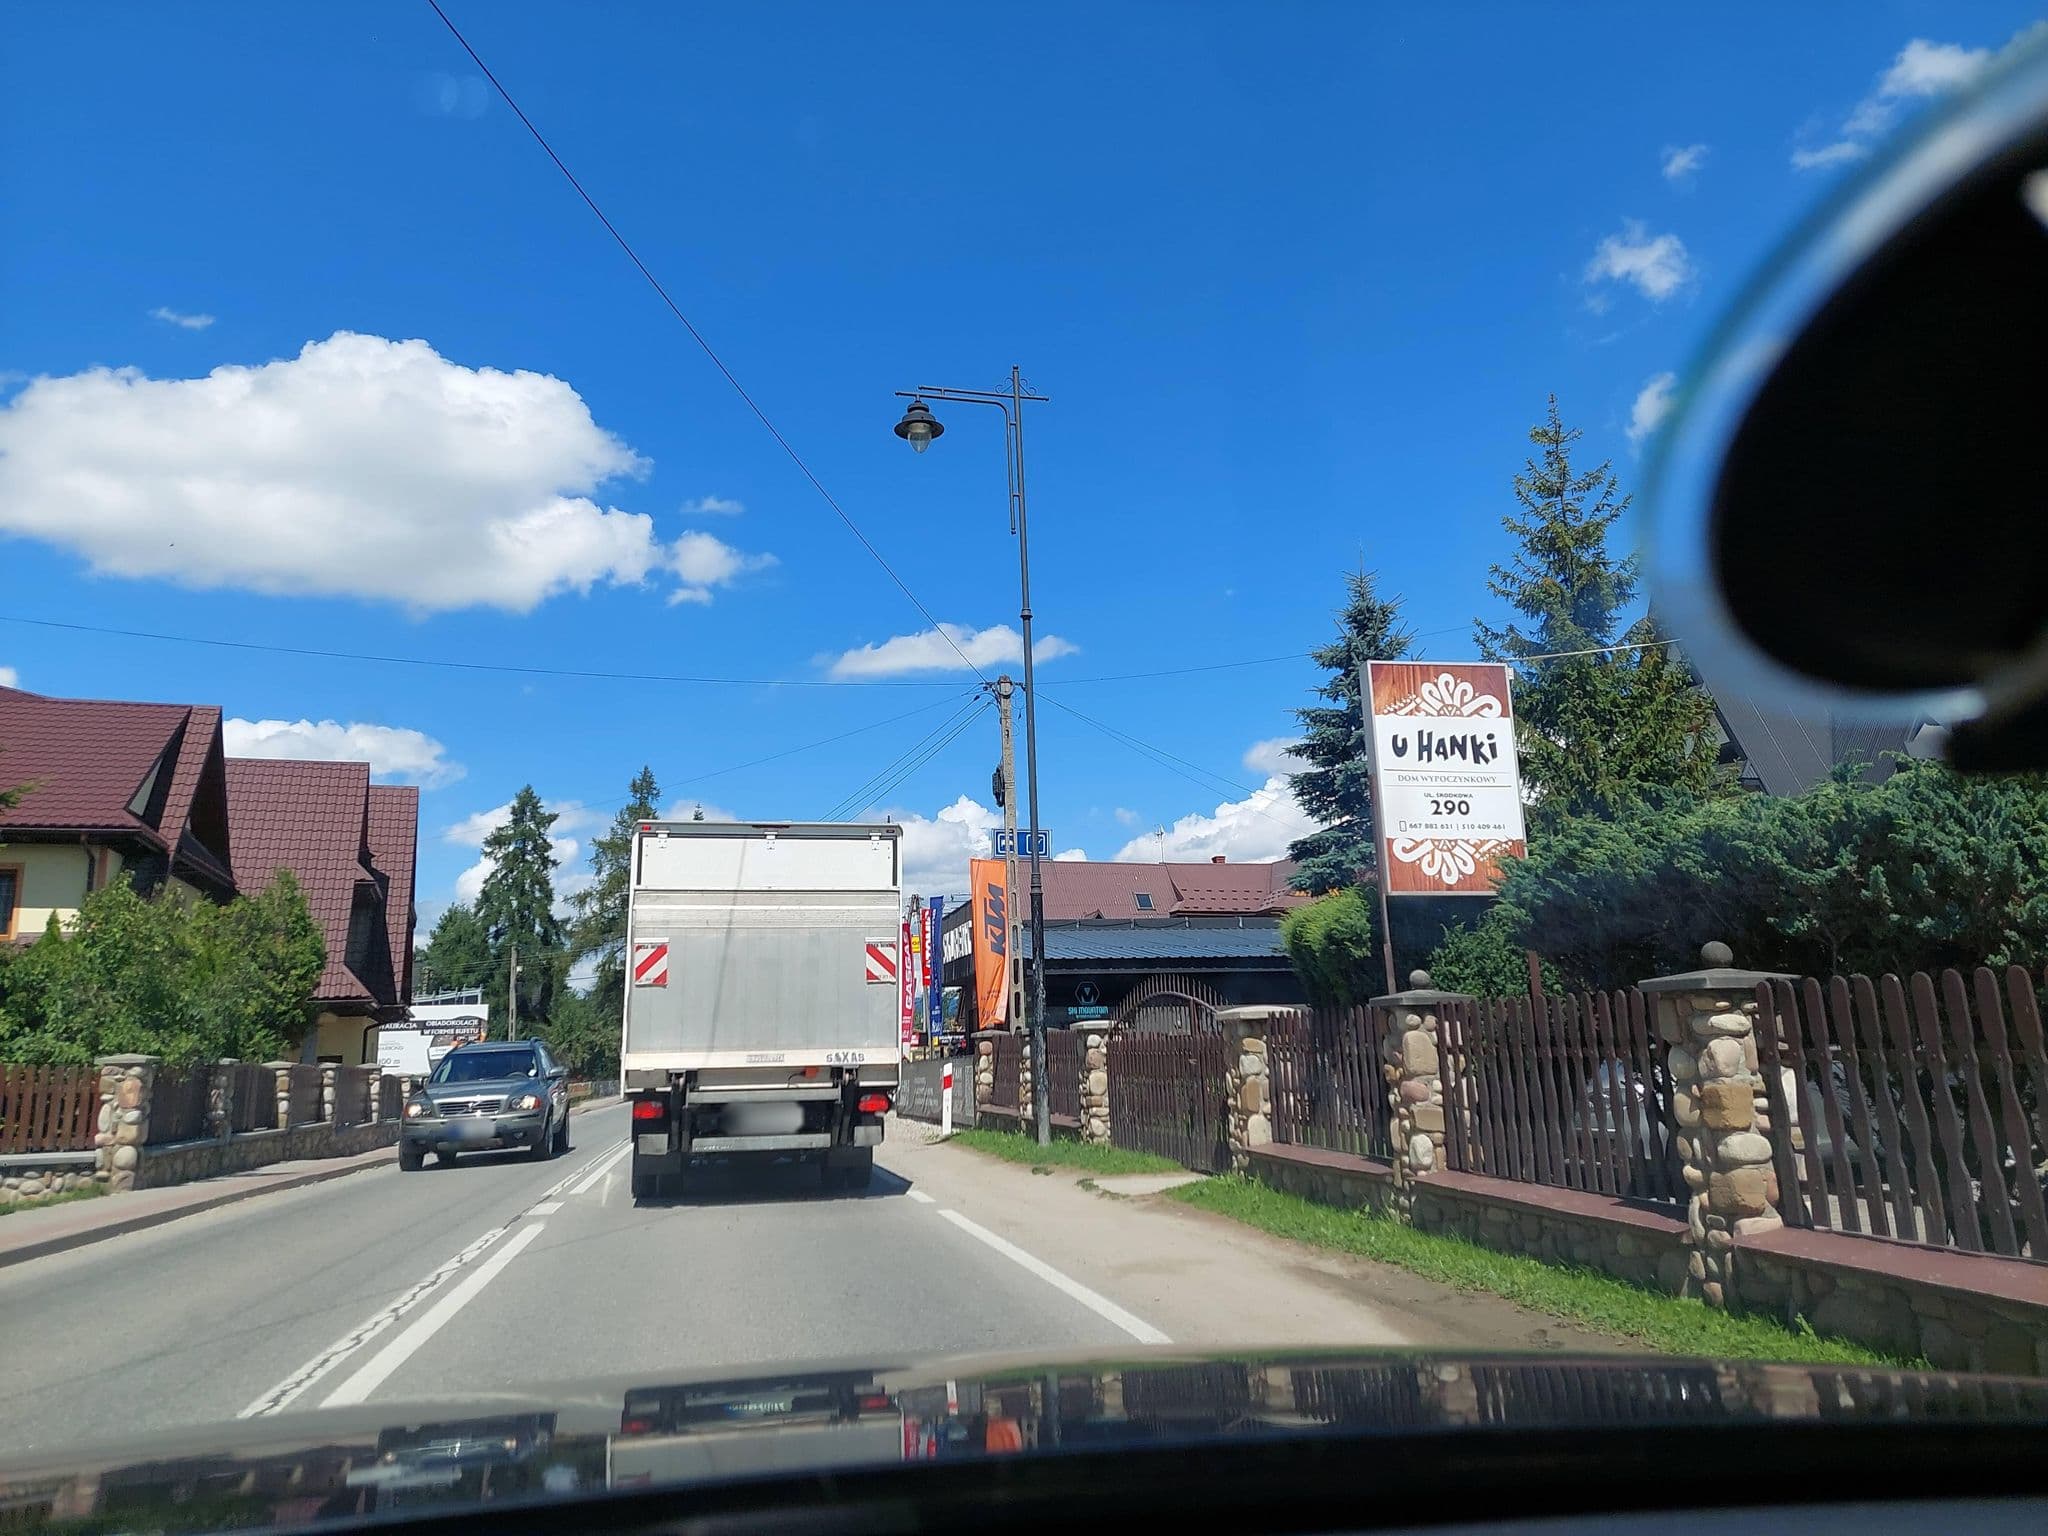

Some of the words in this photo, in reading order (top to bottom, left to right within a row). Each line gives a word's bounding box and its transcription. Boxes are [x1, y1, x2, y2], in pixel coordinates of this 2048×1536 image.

[1397, 774, 1419, 782] DOM
[1420, 775, 1497, 783] WYPOCZYNKOWY
[1430, 800, 1470, 816] 290
[984, 883, 1005, 956] KTM
[903, 930, 913, 1010] GASGAS
